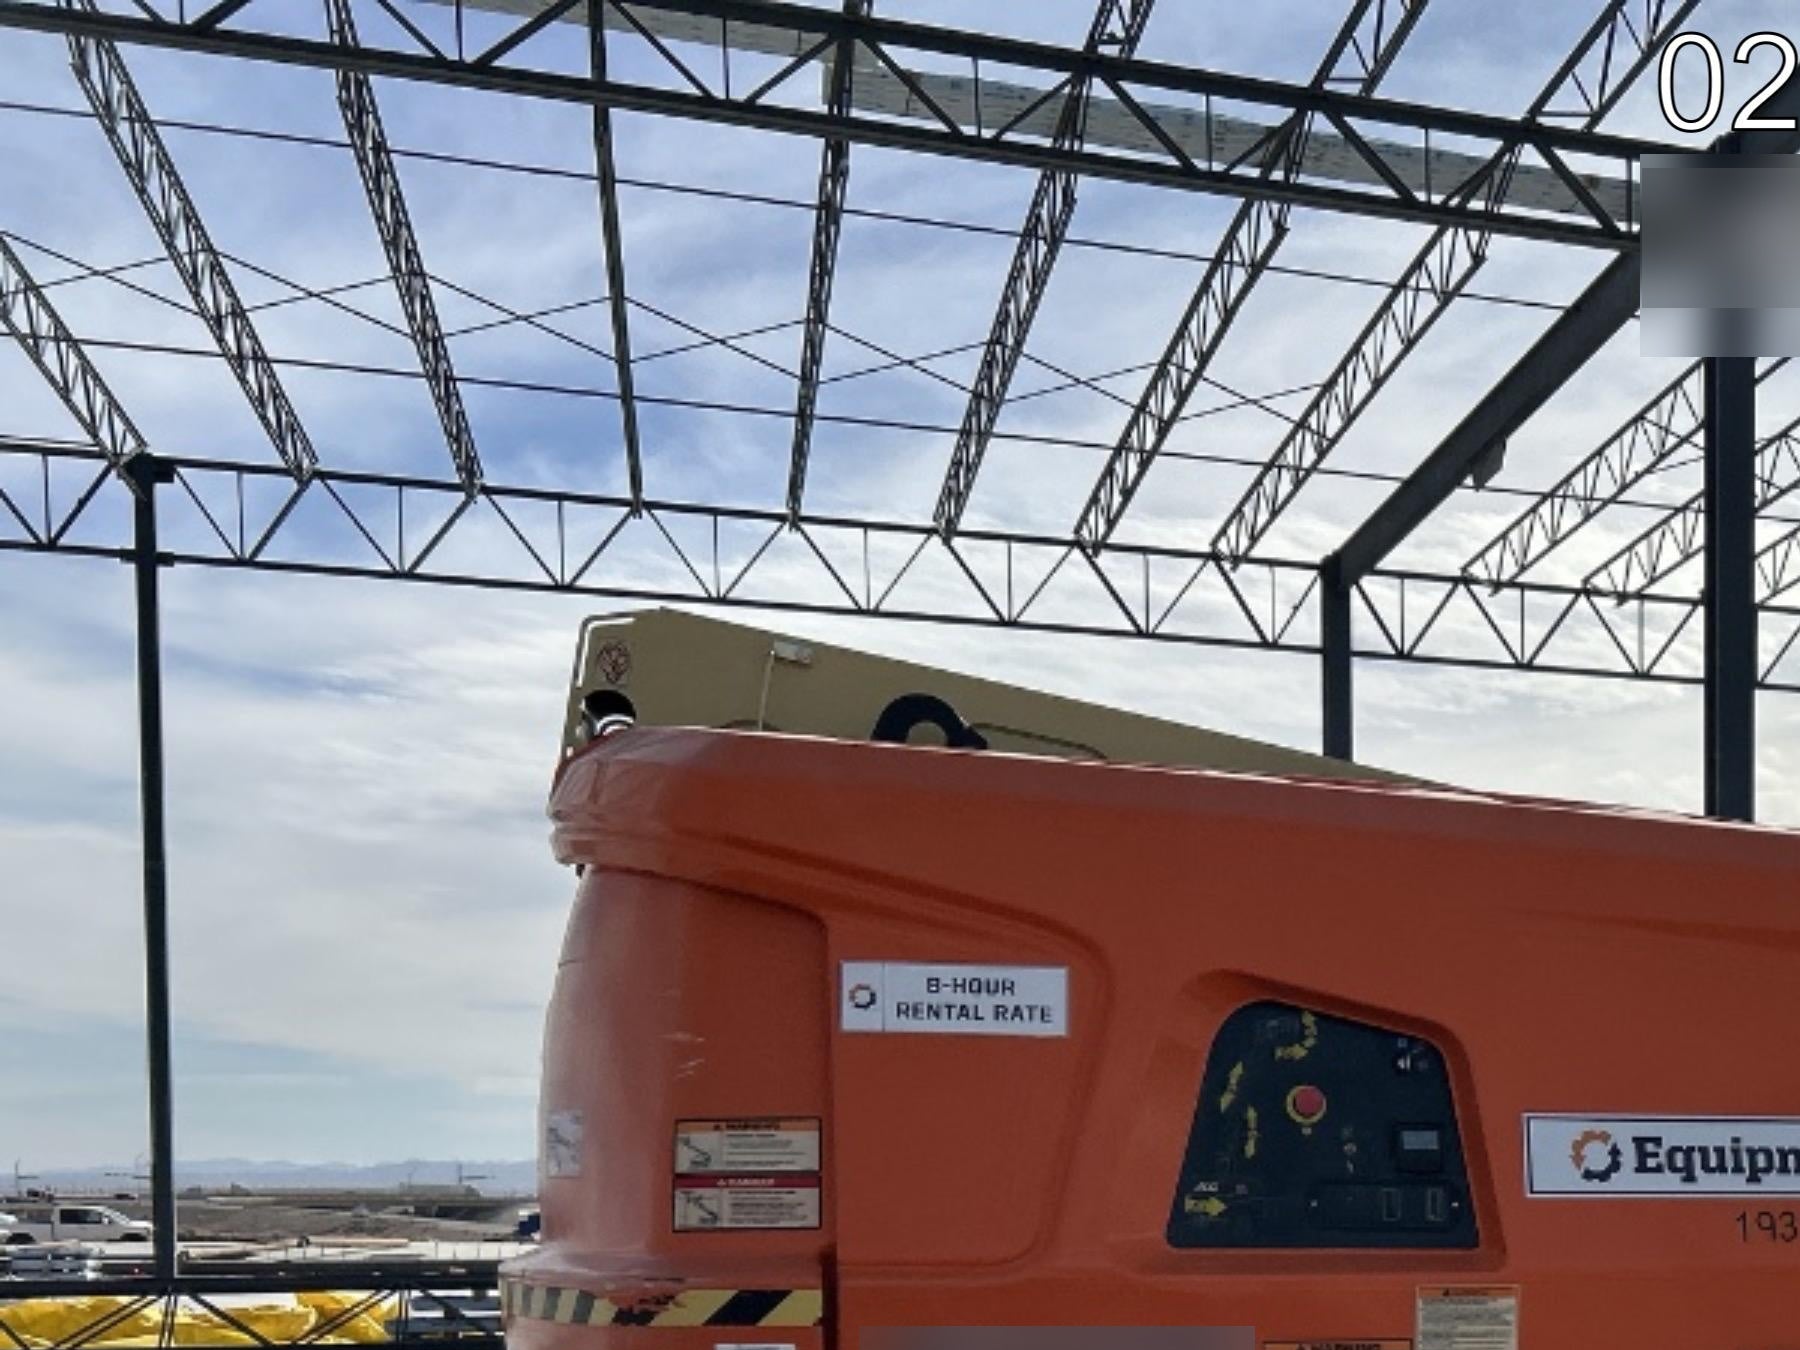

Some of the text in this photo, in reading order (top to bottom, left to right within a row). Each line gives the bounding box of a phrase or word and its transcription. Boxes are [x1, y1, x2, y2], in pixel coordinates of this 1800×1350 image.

[926, 977, 1016, 996] 8-HOUR
[896, 1002, 1054, 1023] RENTAL RATE
